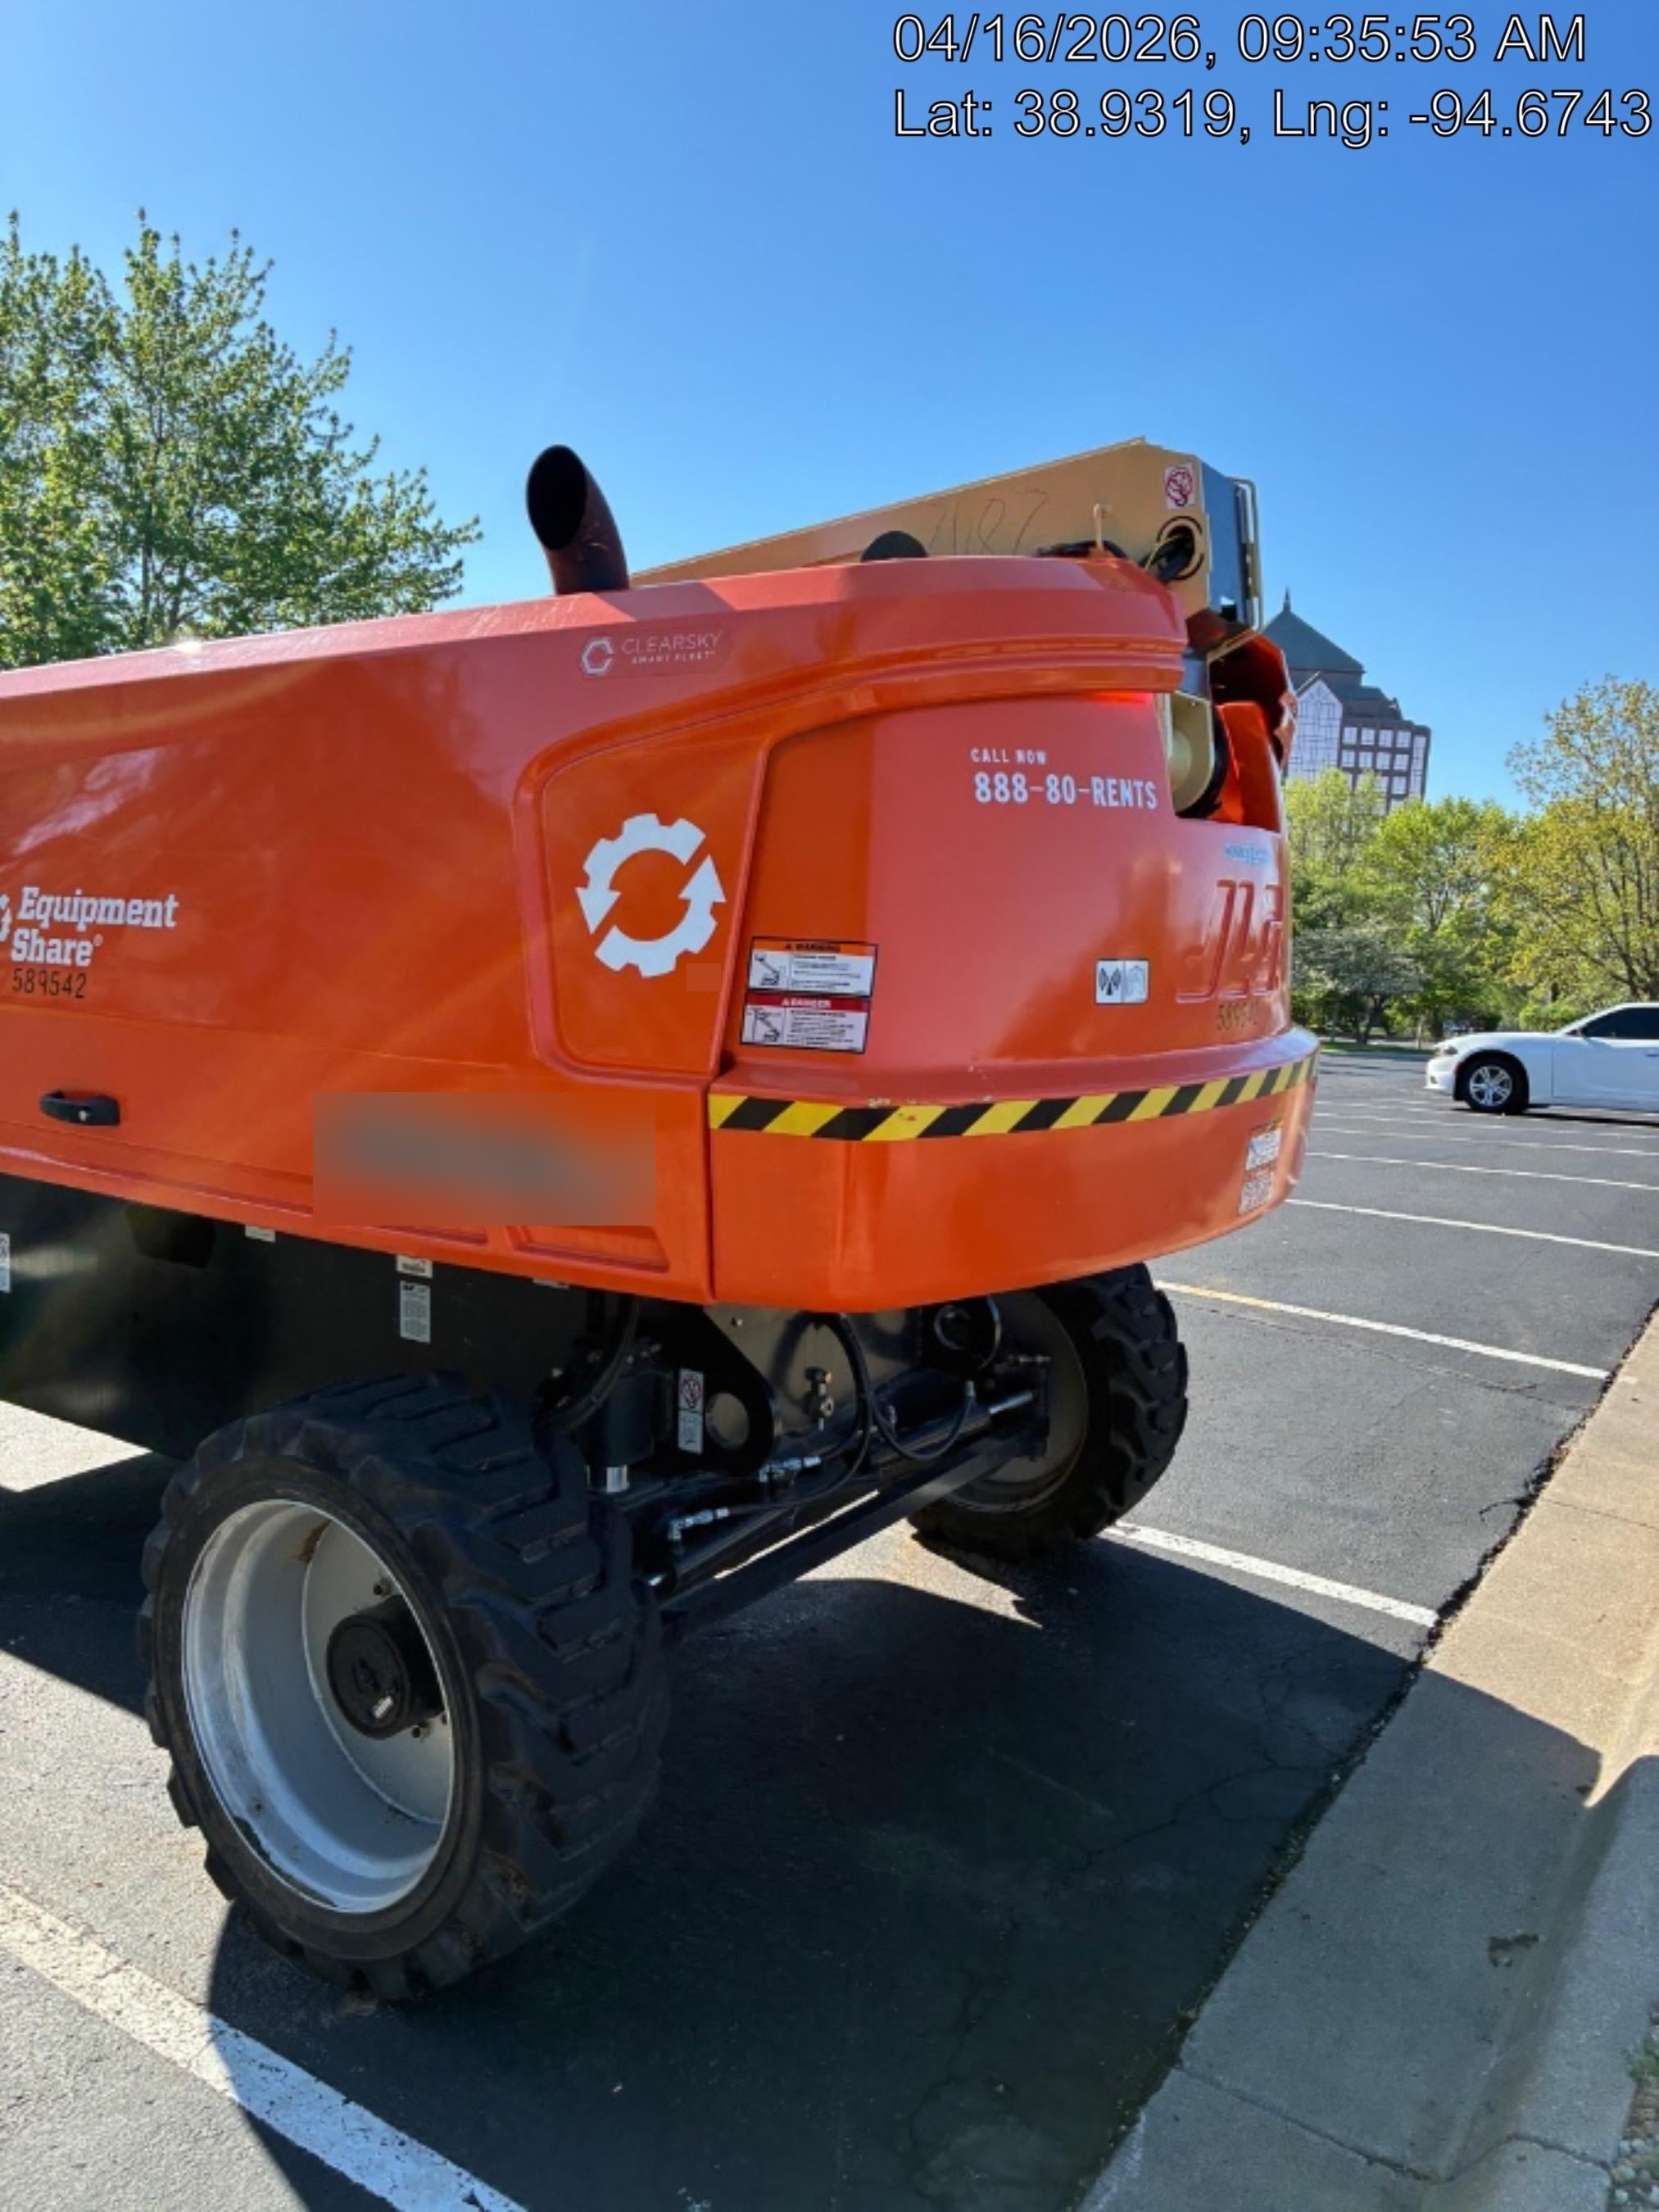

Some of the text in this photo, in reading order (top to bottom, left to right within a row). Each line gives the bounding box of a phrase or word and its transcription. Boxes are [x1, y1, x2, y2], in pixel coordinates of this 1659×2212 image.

[620, 630, 723, 655] CLEARSKY
[970, 747, 1047, 765] CALL NOW
[973, 771, 1158, 809] 888-80-RENTS
[16, 886, 179, 932] Equipment
[11, 968, 88, 999] 589542
